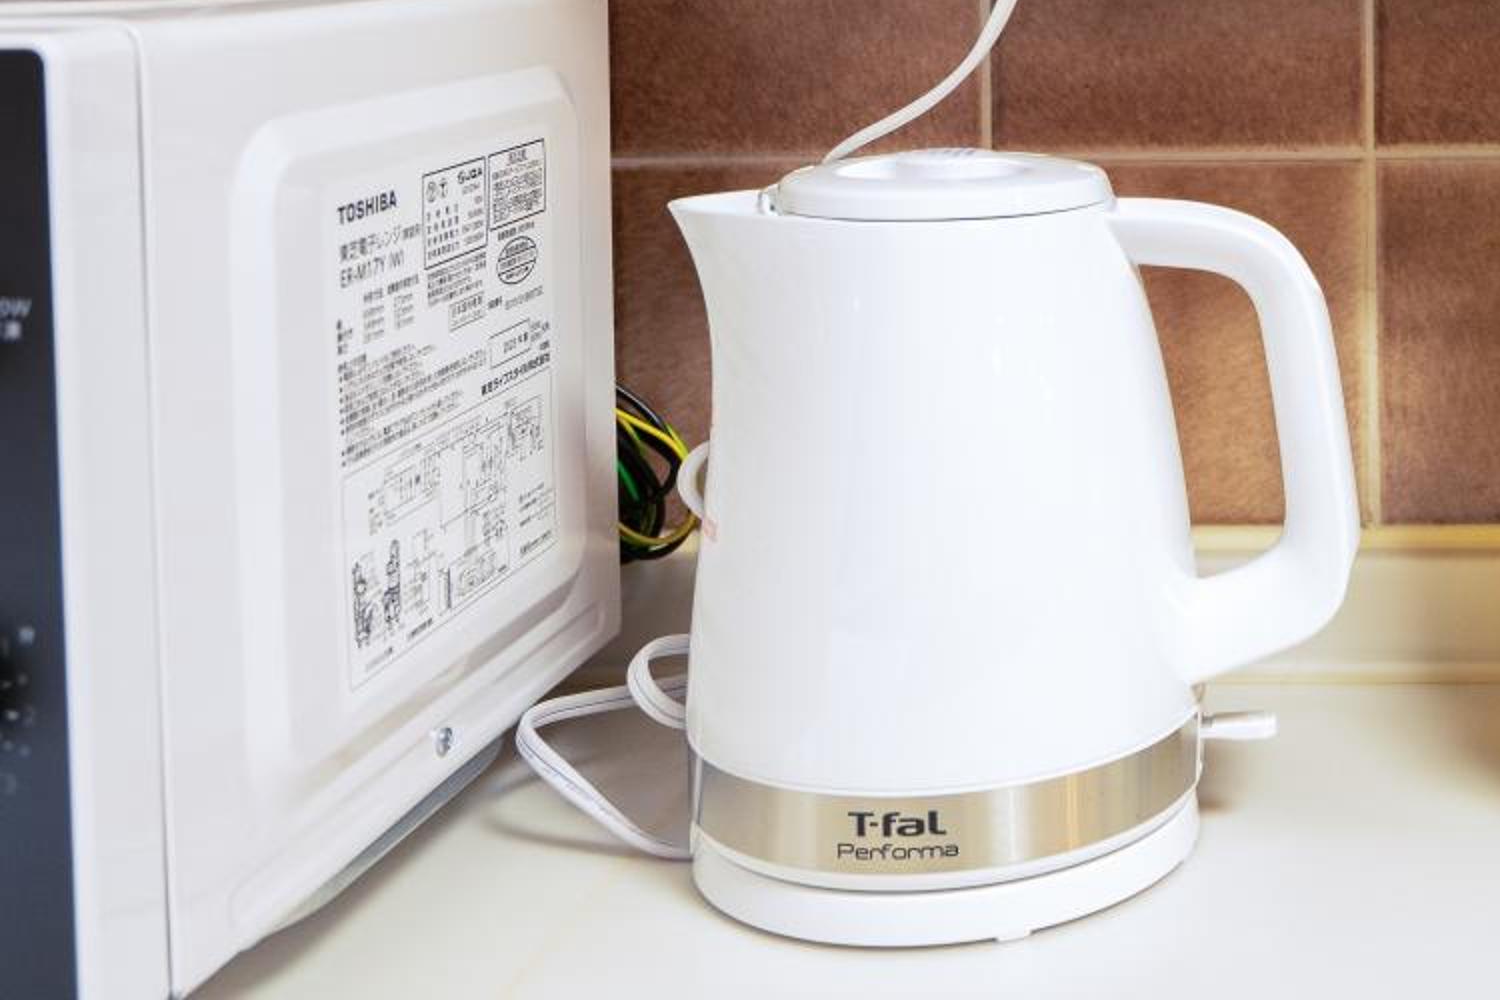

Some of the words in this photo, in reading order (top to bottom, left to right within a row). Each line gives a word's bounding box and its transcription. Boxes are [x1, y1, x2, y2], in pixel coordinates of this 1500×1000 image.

[337, 189, 398, 226] TOSHIBA
[847, 810, 947, 837] T-fal
[837, 843, 960, 860] Performa
